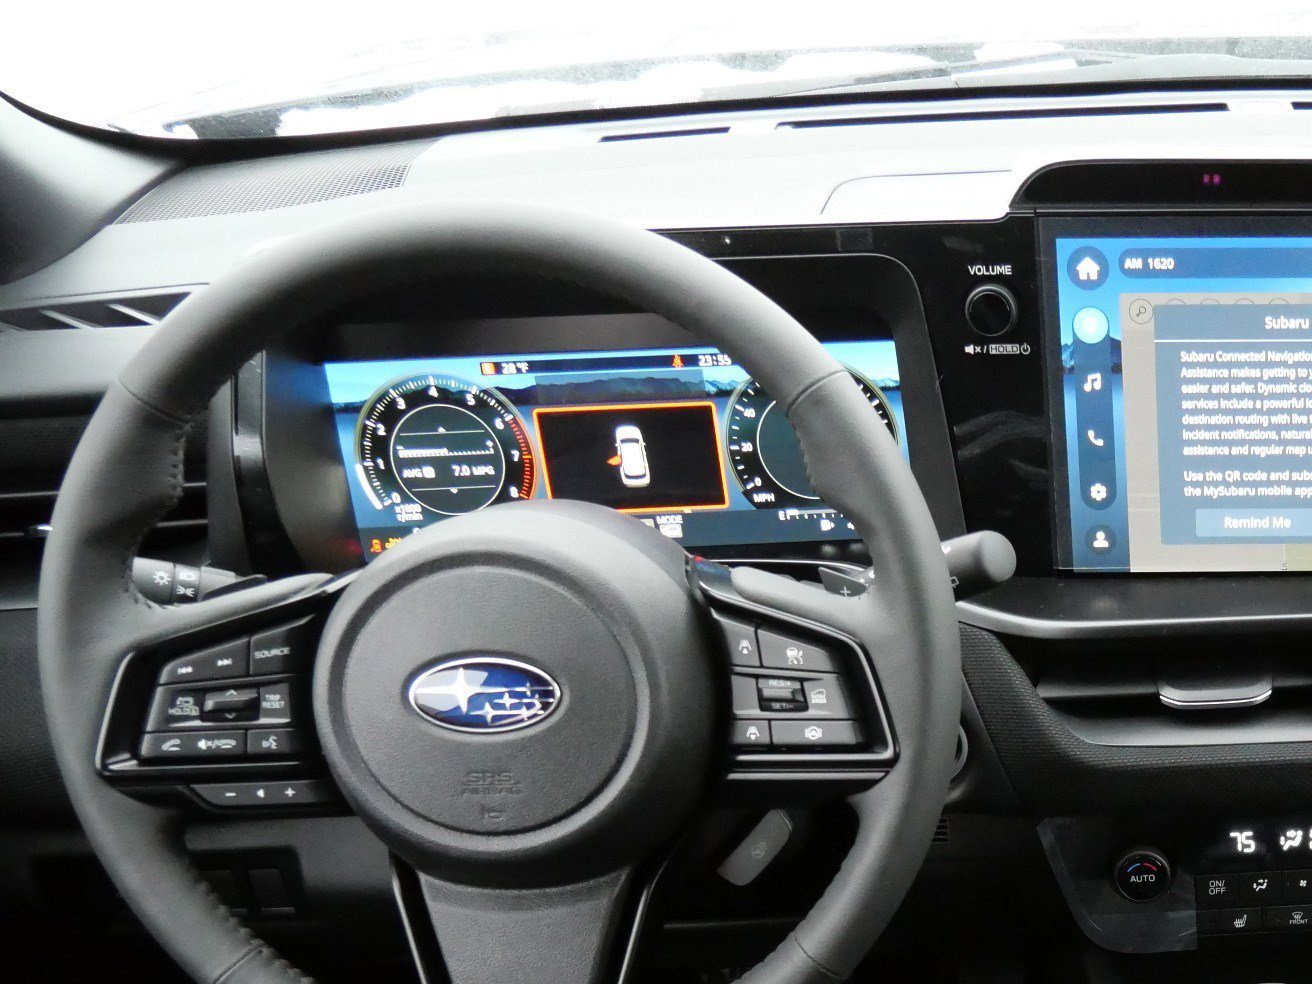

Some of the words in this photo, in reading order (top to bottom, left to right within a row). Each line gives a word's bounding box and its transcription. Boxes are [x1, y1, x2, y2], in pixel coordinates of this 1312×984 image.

[968, 265, 1012, 275] VOLUME
[1124, 258, 1143, 270] AM
[1147, 258, 1175, 270] 1620
[1264, 316, 1309, 330] Subaru
[989, 344, 1019, 354] HOLD
[698, 354, 732, 366] 23:55
[1180, 351, 1214, 362] Subaru
[1216, 351, 1266, 362] Connected
[1181, 367, 1229, 378] Assistance
[1231, 367, 1261, 378] makes
[1263, 366, 1296, 380] getting
[1298, 367, 1308, 378] to
[428, 386, 438, 397] 4
[1181, 382, 1209, 394] easier
[1211, 382, 1229, 393] and
[1231, 382, 1256, 393] safer.
[1257, 382, 1297, 396] Dynamic
[397, 397, 406, 409] 3
[466, 393, 476, 405] 5
[1181, 398, 1219, 410] services
[1220, 398, 1253, 409] include
[1255, 401, 1262, 409] a
[1263, 397, 1304, 411] powerful
[743, 408, 756, 418] 40
[494, 418, 504, 430] 6
[1182, 414, 1233, 425] destination
[1235, 413, 1269, 427] routing
[1270, 413, 1290, 424] with
[1292, 413, 1308, 424] live
[376, 424, 386, 436] 2
[1182, 429, 1219, 440] incident
[1221, 429, 1279, 441] notifications,
[1280, 429, 1312, 440] natural
[741, 442, 753, 452] 20
[1183, 445, 1229, 456] assistance
[1231, 444, 1248, 456] and
[1250, 444, 1284, 457] regular
[1285, 446, 1306, 458] map
[511, 451, 519, 462] 7
[377, 458, 385, 470] 1
[403, 470, 422, 478] AVG
[452, 465, 471, 477] 7.0
[1183, 471, 1204, 482] Use
[1205, 470, 1223, 482] the
[1224, 470, 1241, 483] QR
[1242, 470, 1267, 481] code
[1269, 470, 1289, 481] and
[754, 478, 762, 487] 0
[391, 492, 401, 503] 0
[509, 487, 519, 498] 8
[1184, 485, 1201, 497] the
[1203, 485, 1256, 498] MySubaru
[1257, 485, 1293, 496] mobile
[753, 493, 775, 503] MPH
[656, 515, 683, 524] MODE
[778, 510, 787, 521] E
[1224, 516, 1270, 529] Remind
[1272, 516, 1292, 529] Me
[254, 647, 291, 659] SOURCE
[1229, 831, 1256, 853] 75
[1130, 875, 1155, 883] AUTO
[1209, 880, 1225, 888] ON/
[1209, 887, 1226, 895] OFF
